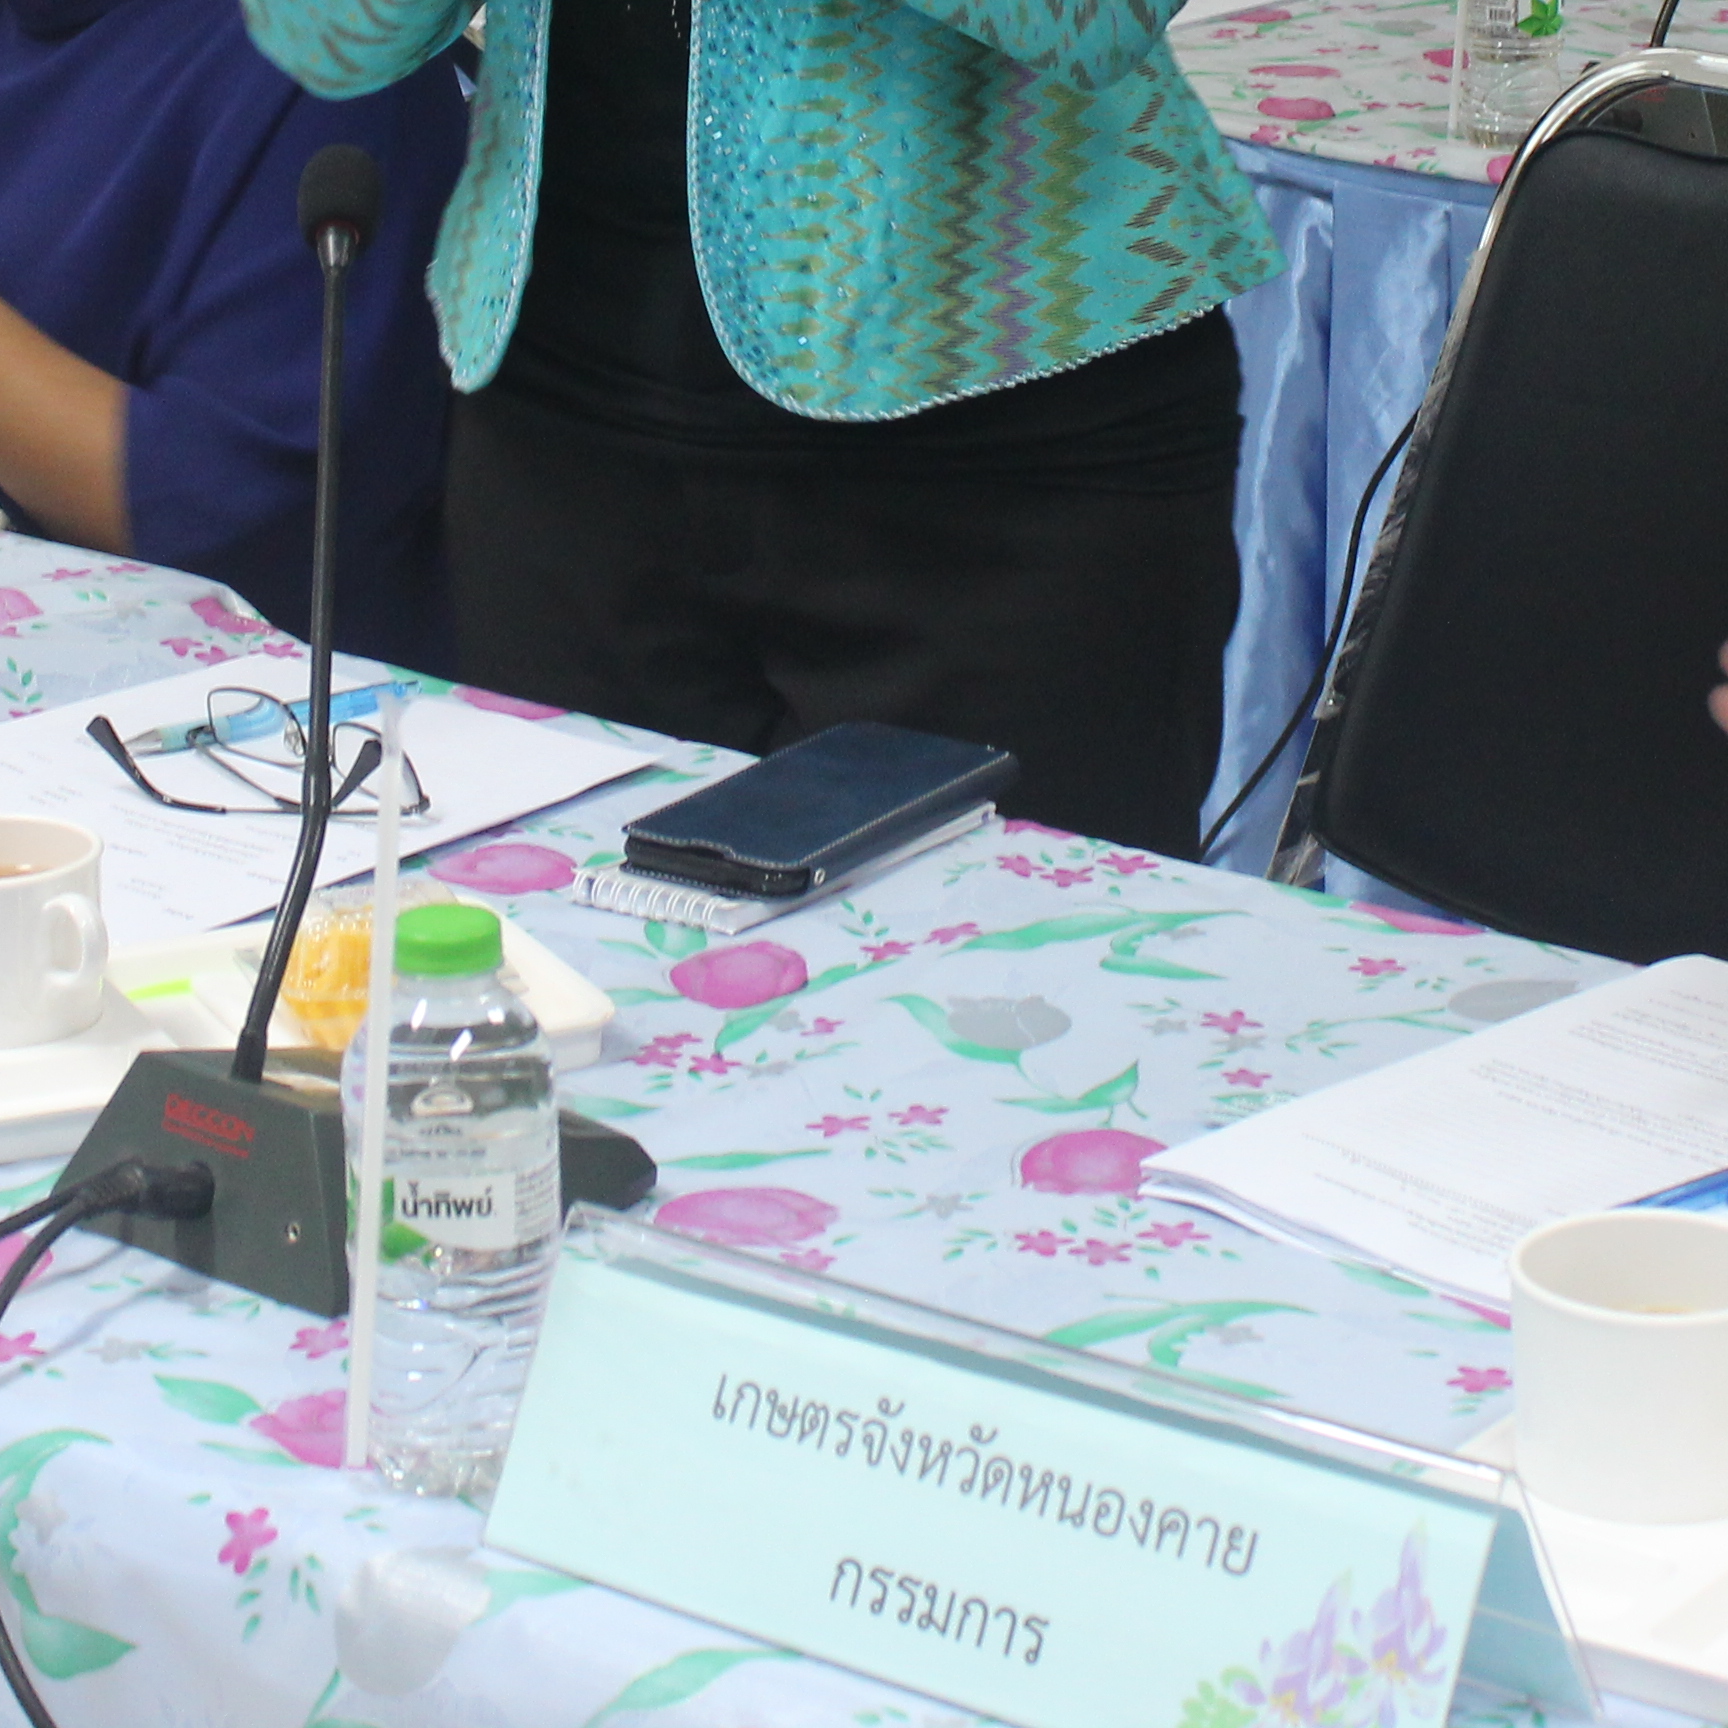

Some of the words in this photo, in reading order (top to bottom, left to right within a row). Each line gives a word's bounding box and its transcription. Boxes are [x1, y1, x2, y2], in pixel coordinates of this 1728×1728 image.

[711, 1372, 1260, 1578] เกษตรจังหวัดหนองคาย
[828, 1556, 1052, 1667] กรรมการ
